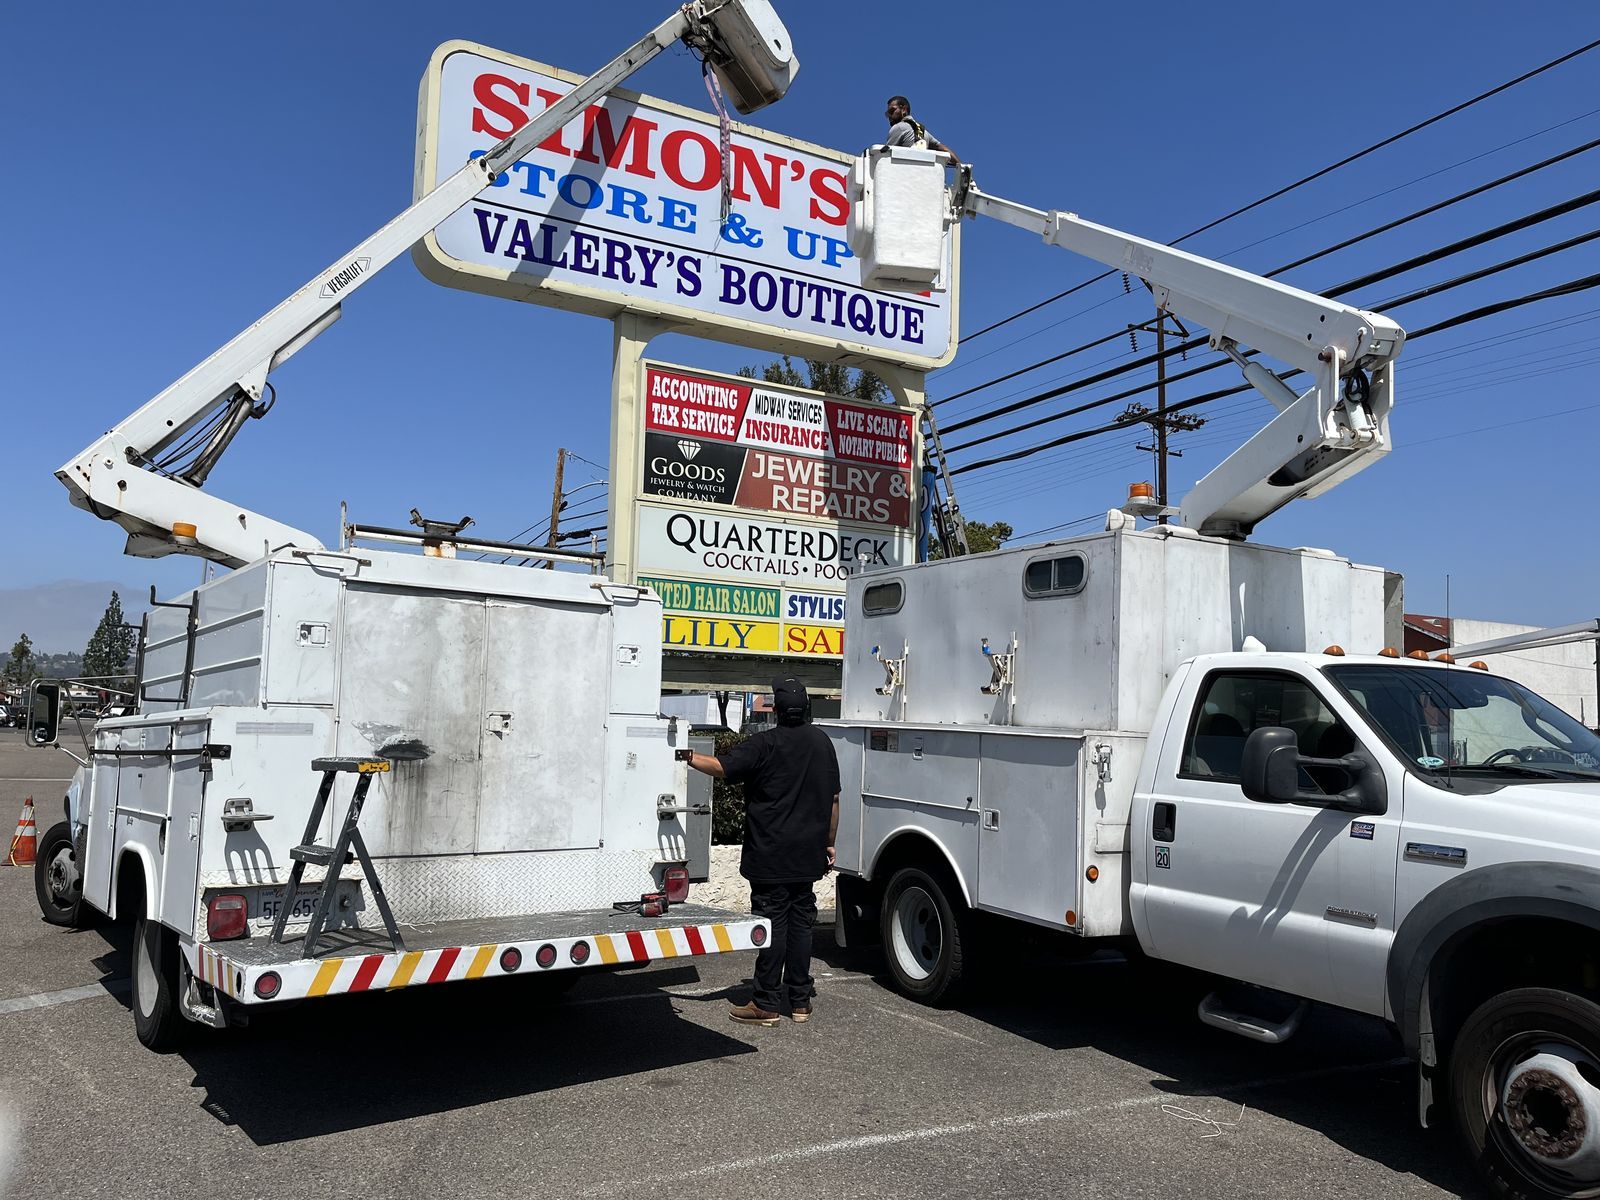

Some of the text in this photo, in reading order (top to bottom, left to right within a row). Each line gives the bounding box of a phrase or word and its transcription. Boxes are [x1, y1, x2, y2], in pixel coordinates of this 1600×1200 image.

[719, 212, 764, 249] &
[326, 260, 364, 295] VERSALIFT
[473, 207, 924, 345] VALERY'S BOUTIQUE
[652, 375, 738, 410] ACCOUNTING
[652, 402, 735, 436] TAX SERVICE
[755, 393, 823, 425] MIDWAY SERVICES
[837, 408, 909, 440] LIVE SCAN &
[745, 418, 830, 451] INSURANCE
[838, 434, 908, 464] NOTARY PUBLIC
[650, 477, 725, 493] JEWELRY & WATCH
[651, 457, 725, 483] GOODS
[752, 453, 909, 499] JEWELRY &
[657, 488, 717, 502] COMPANY
[772, 484, 890, 523] REPAIRS
[666, 513, 889, 566] QUARTERDECK
[703, 551, 799, 576] COCKTAILS
[637, 579, 777, 616] ITED HAIR SALON
[788, 594, 846, 621] STYLIS
[662, 617, 757, 649] LILY
[1157, 852, 1169, 867] 20
